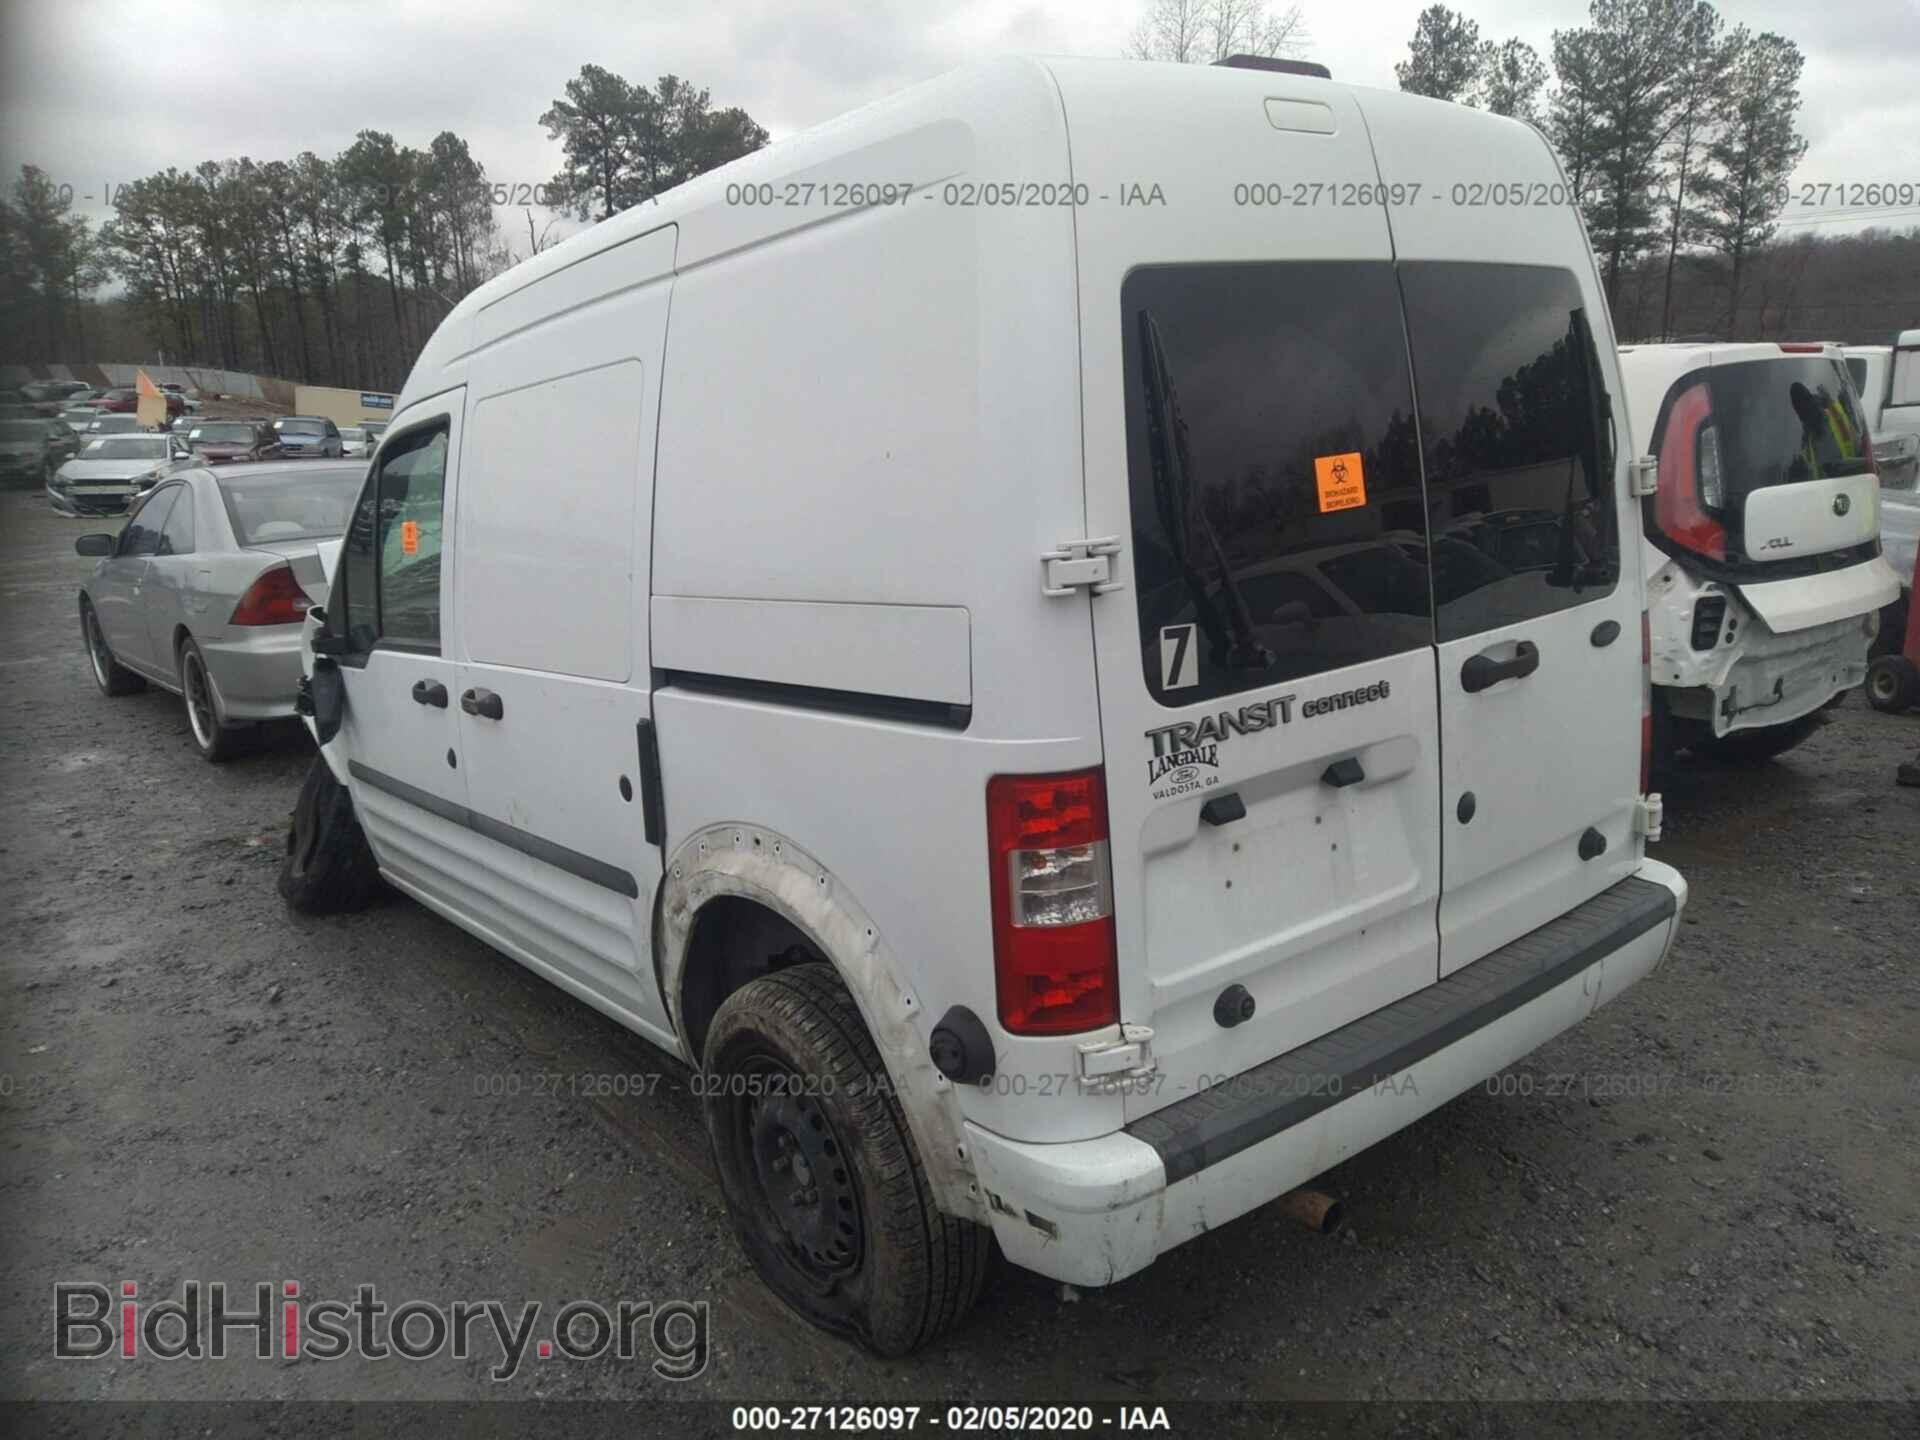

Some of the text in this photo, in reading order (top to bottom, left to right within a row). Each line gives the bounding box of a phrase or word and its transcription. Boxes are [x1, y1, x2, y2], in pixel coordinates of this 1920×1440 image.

[1163, 625, 1192, 687] 7
[1144, 679, 1391, 758] TRANSIT connect
[1147, 743, 1219, 786] LANGDALE
